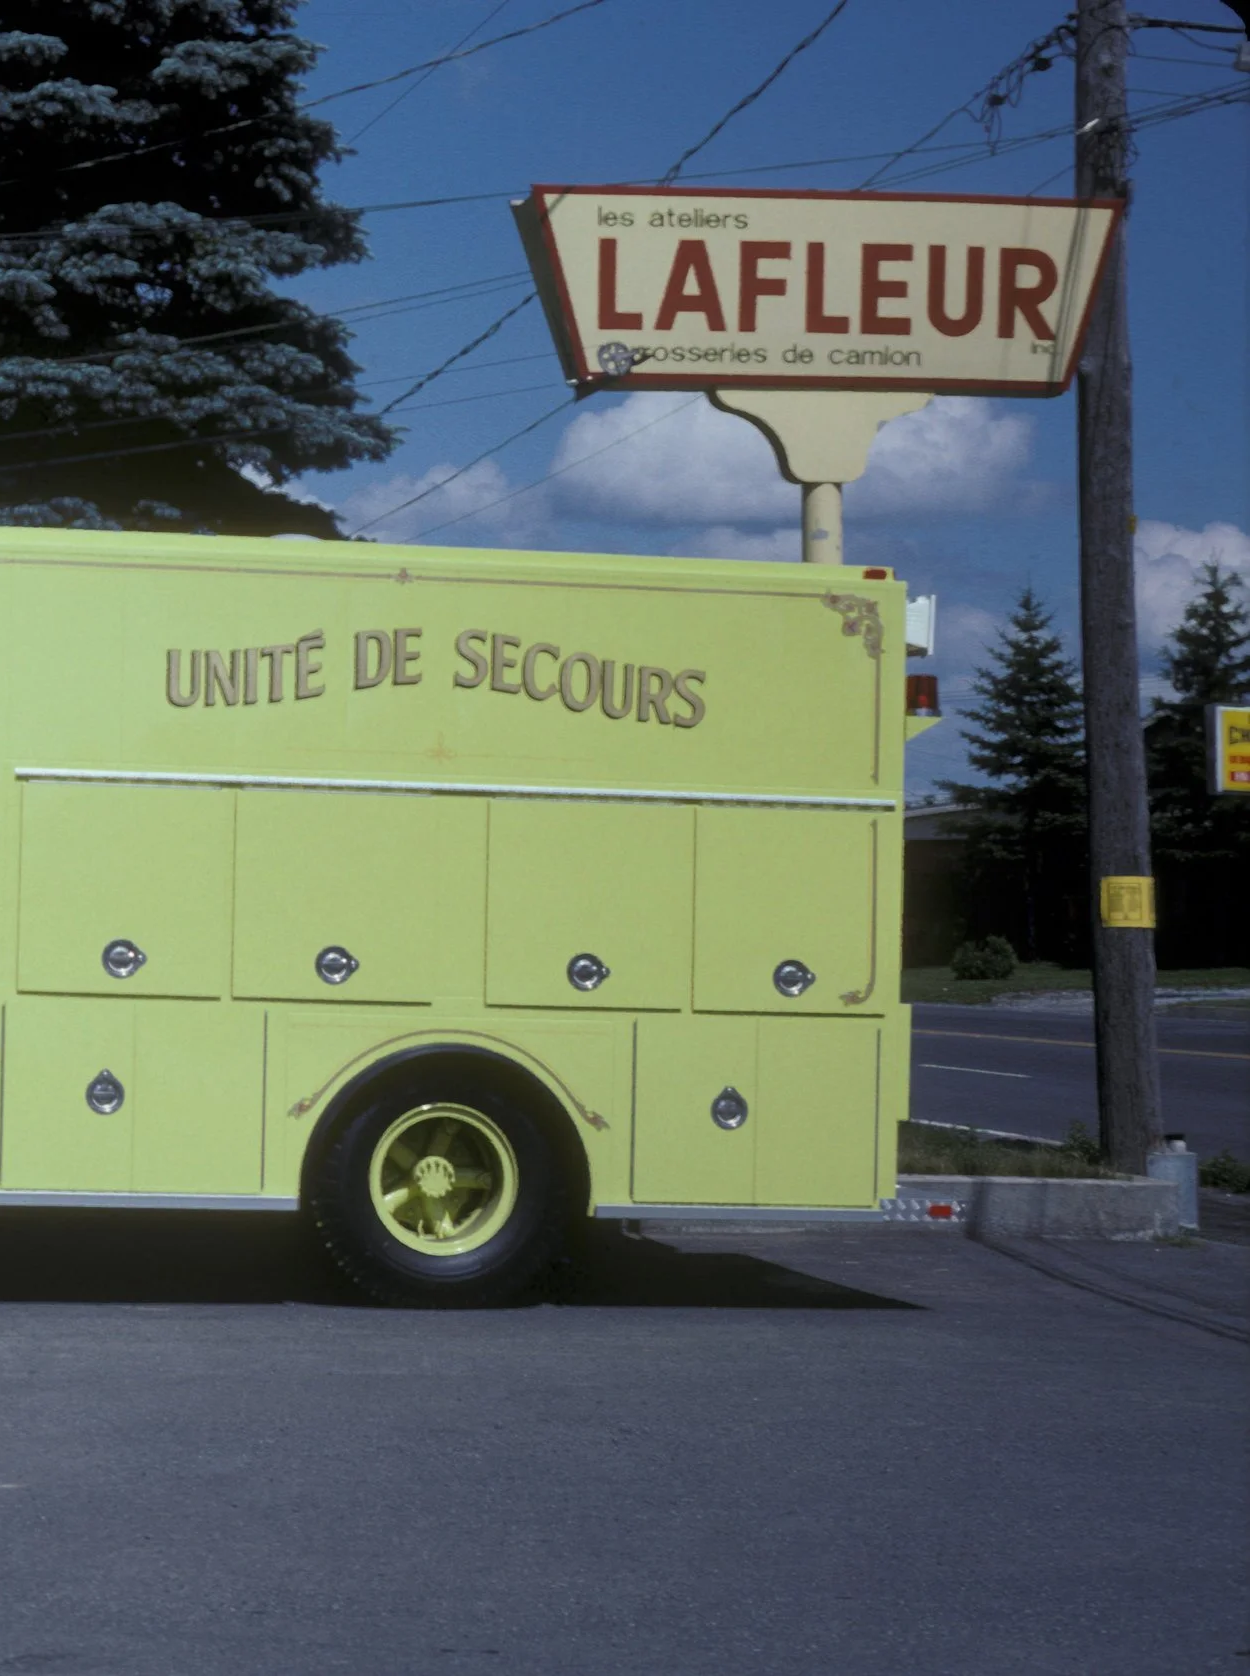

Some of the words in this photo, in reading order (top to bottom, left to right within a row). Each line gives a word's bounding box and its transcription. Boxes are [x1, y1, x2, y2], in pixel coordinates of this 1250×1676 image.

[597, 204, 634, 228] les
[649, 208, 749, 230] ateliers
[597, 237, 1059, 341] LAFLEUR
[600, 341, 768, 364] rosseries
[782, 343, 814, 365] de
[829, 343, 922, 368] camion
[166, 627, 327, 708] UNITÉ
[353, 627, 423, 691] DE
[453, 628, 707, 729] SECOURS
